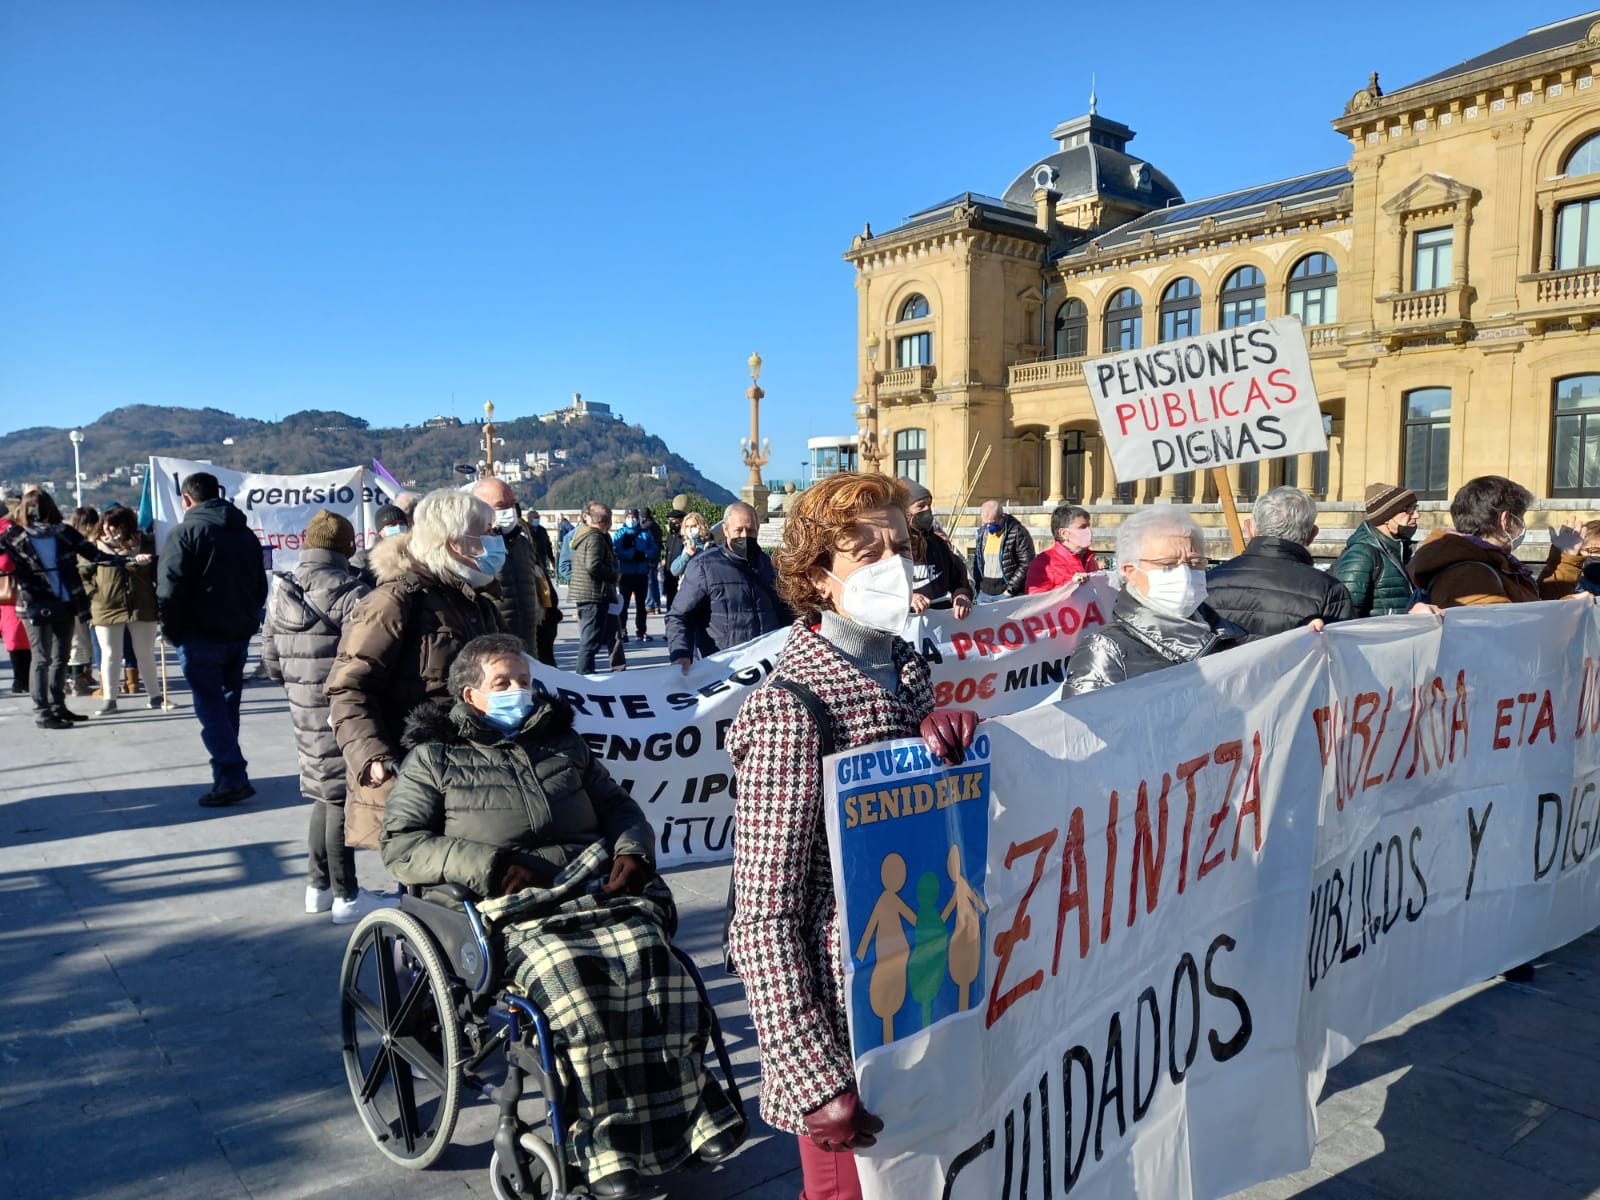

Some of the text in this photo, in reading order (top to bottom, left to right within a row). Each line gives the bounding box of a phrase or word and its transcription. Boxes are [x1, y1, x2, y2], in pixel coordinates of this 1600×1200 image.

[1097, 328, 1278, 398] PENSIONES
[1152, 415, 1287, 472] DIGNAS
[246, 483, 354, 511] pentsio
[913, 564, 936, 581] NIE
[951, 601, 1106, 661] PROPIOA
[837, 734, 991, 785] GIPUZKO
[844, 771, 984, 830] SENIDEAK
[660, 815, 736, 855] iTU
[986, 730, 1262, 1031] ZAINTZA
[1493, 689, 1557, 751] ETA
[1308, 826, 1429, 993] UBLICOS
[1465, 801, 1494, 902] Y
